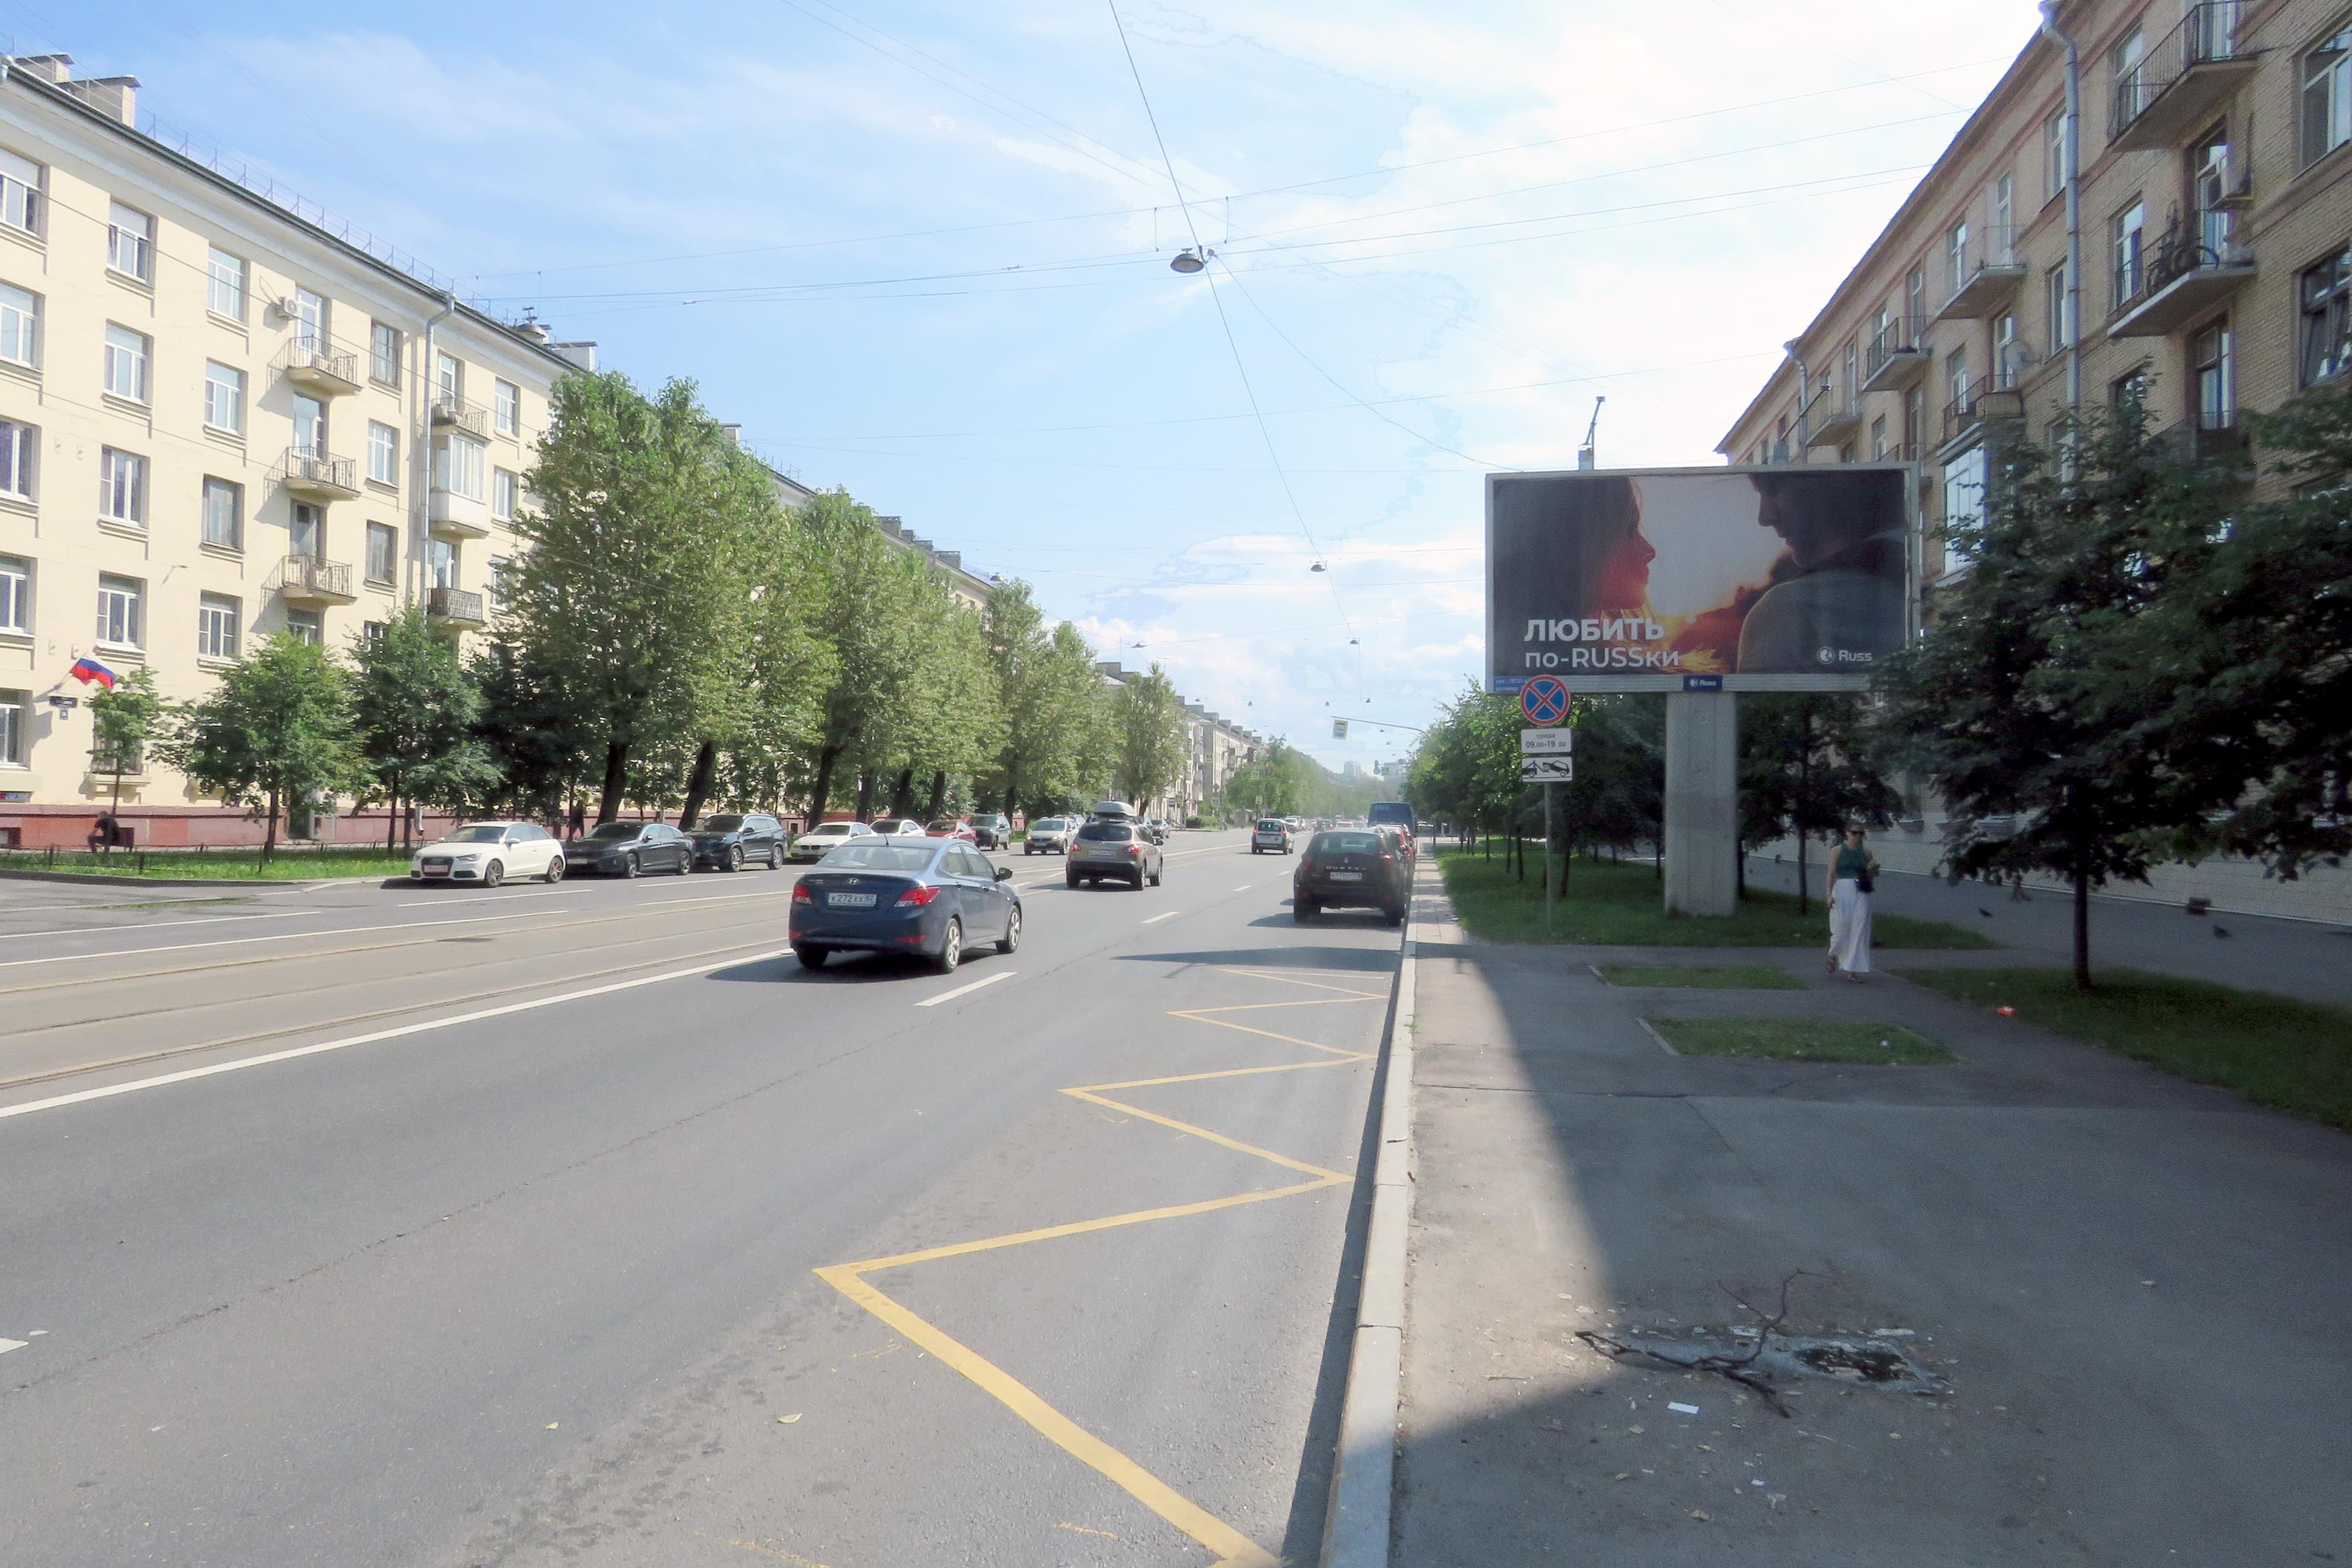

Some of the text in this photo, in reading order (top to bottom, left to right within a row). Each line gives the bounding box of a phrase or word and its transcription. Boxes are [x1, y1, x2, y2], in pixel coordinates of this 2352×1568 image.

[1524, 618, 1665, 641] ЛЮБИТЬ
[1525, 647, 1679, 668] по-RUSSки
[1838, 649, 1872, 662] Russ
